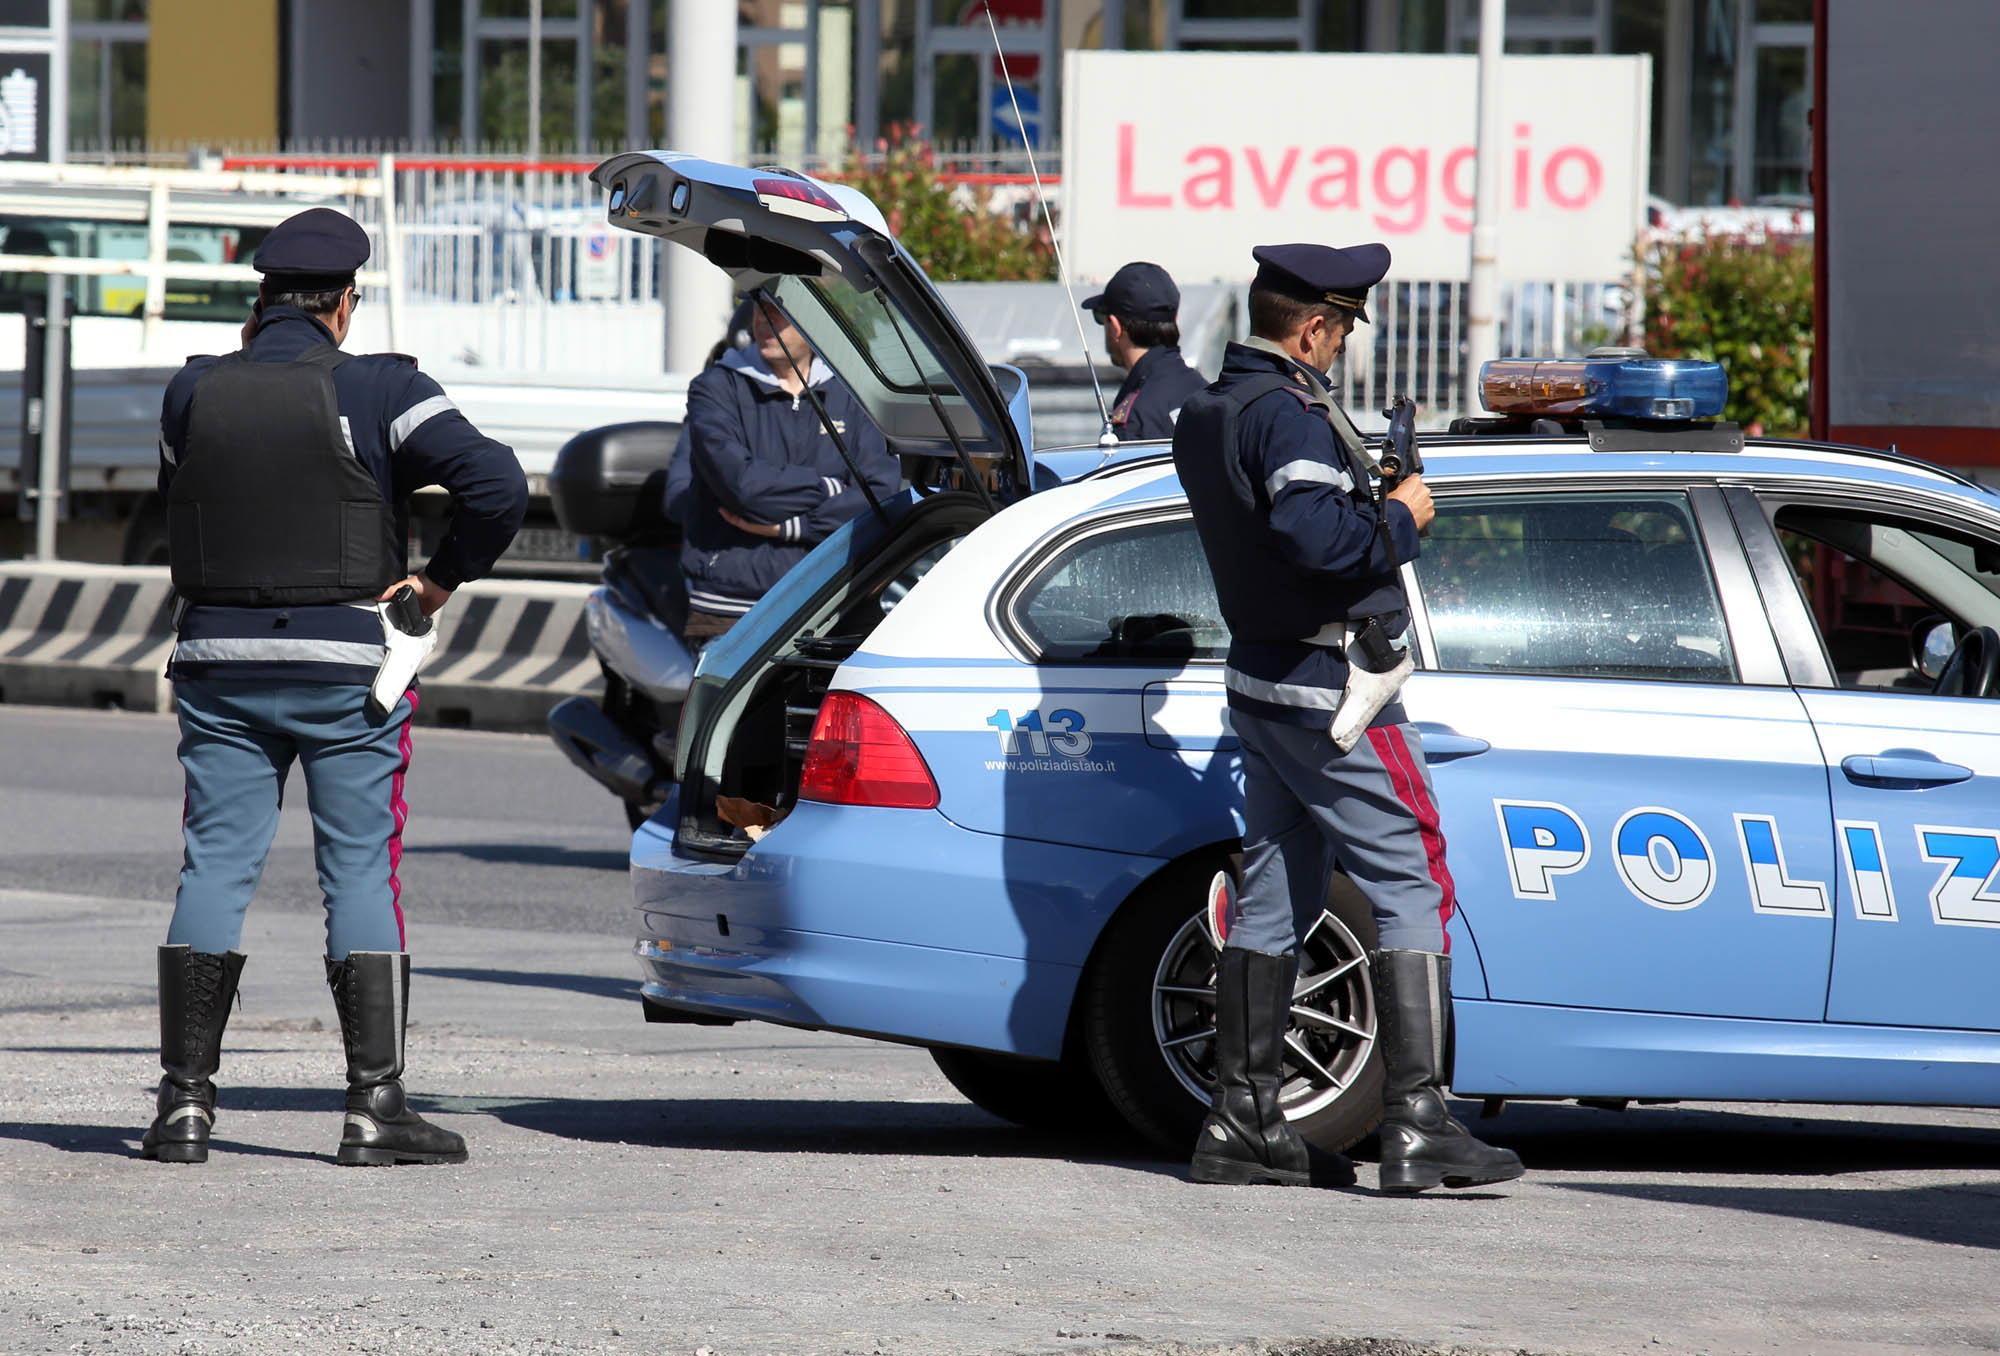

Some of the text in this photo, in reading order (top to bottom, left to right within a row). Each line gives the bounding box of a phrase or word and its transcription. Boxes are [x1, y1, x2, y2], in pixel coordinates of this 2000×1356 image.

[986, 708, 1093, 757] 113
[984, 760, 1116, 773] www.poliziadistato.it
[1492, 798, 2000, 928] POLIZ
